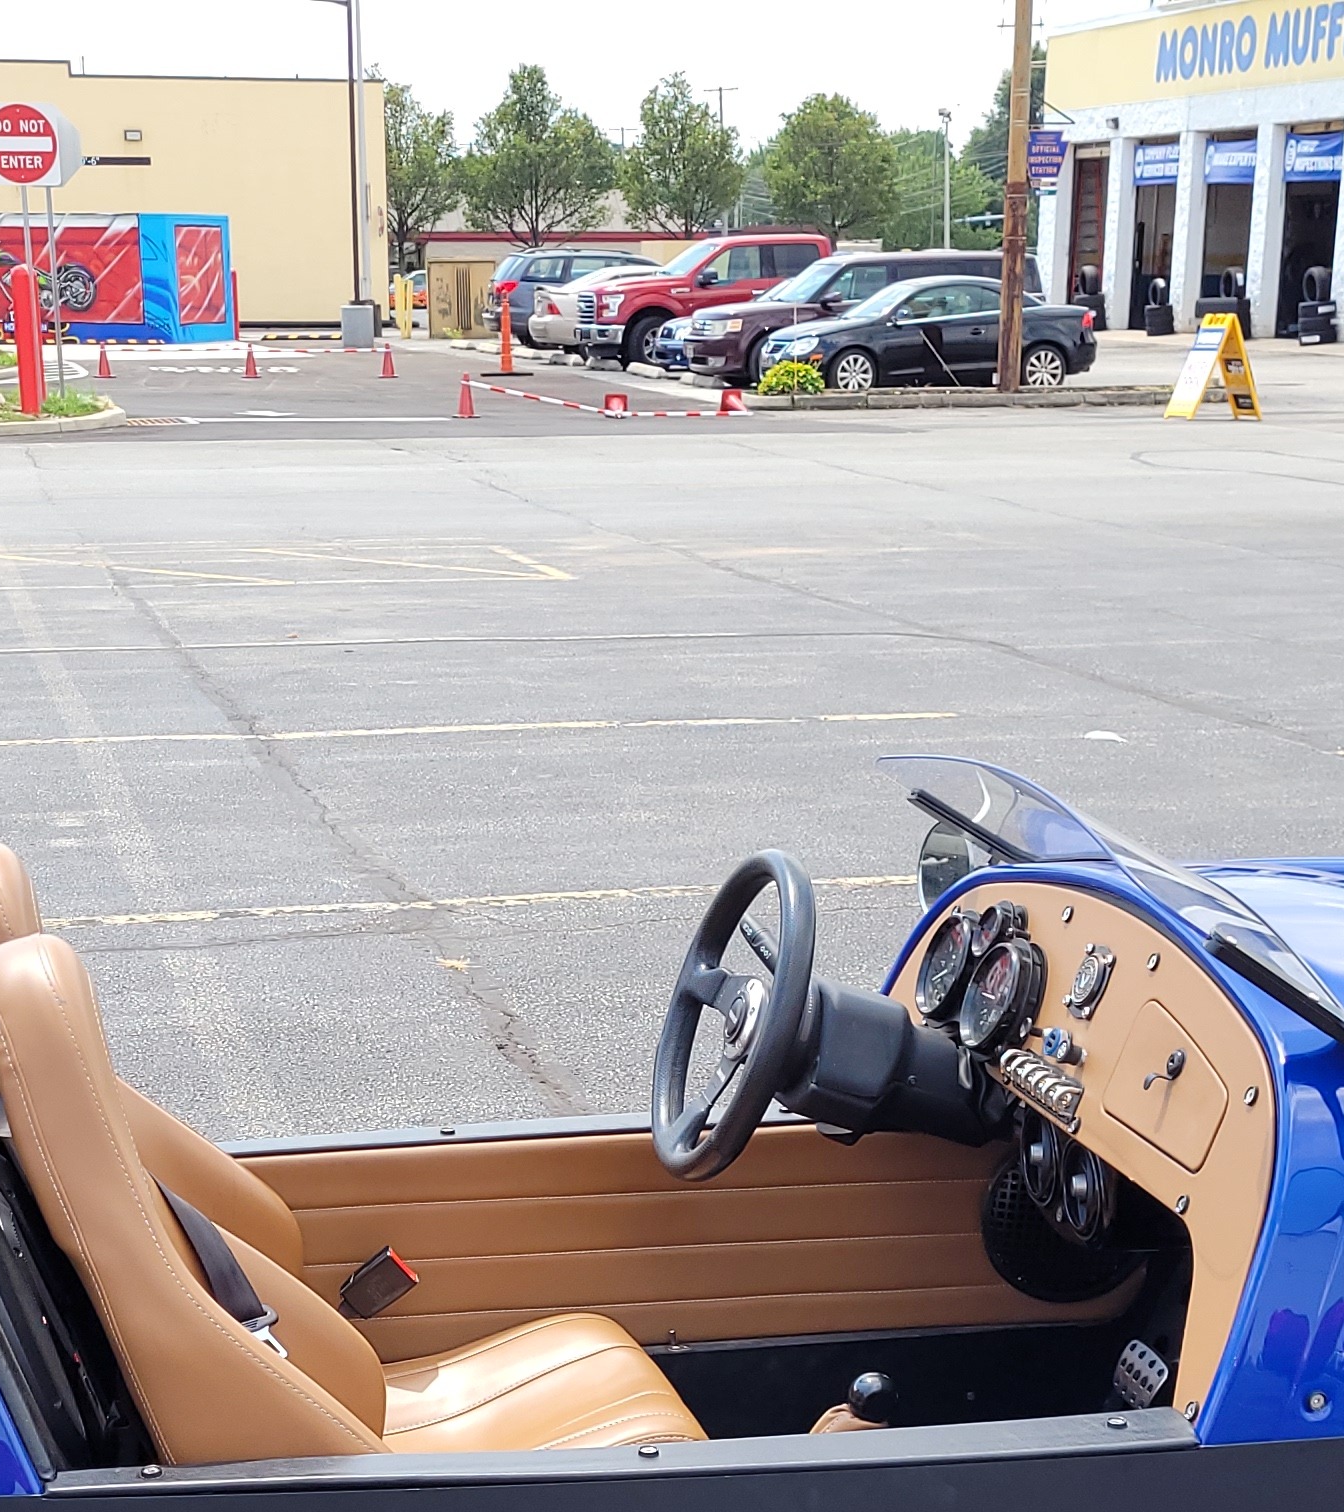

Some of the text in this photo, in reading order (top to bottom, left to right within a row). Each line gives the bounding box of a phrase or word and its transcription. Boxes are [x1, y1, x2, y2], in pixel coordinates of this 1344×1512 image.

[1155, 15, 1258, 83] MONRO
[19, 119, 46, 133] NOT
[1031, 145, 1060, 154] OFFICIAL
[0, 155, 43, 169] ENTER
[1031, 165, 1058, 174] STATION
